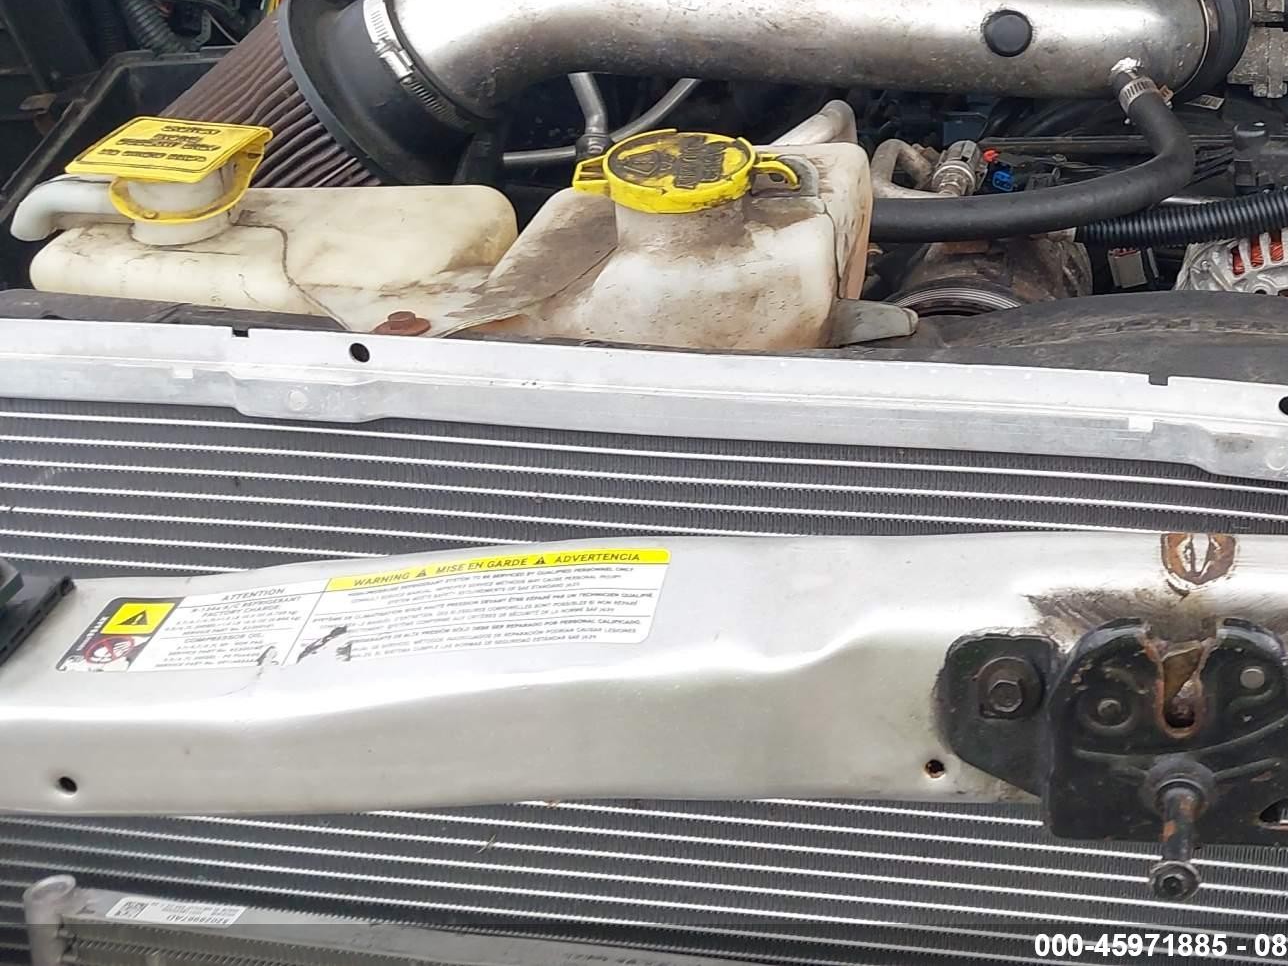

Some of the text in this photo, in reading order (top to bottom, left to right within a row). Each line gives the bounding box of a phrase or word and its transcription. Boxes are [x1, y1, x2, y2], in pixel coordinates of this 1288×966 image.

[354, 553, 641, 587] WARNING MISE EN GARDE ADVERTENCIA
[221, 588, 286, 601] ATTENTION
